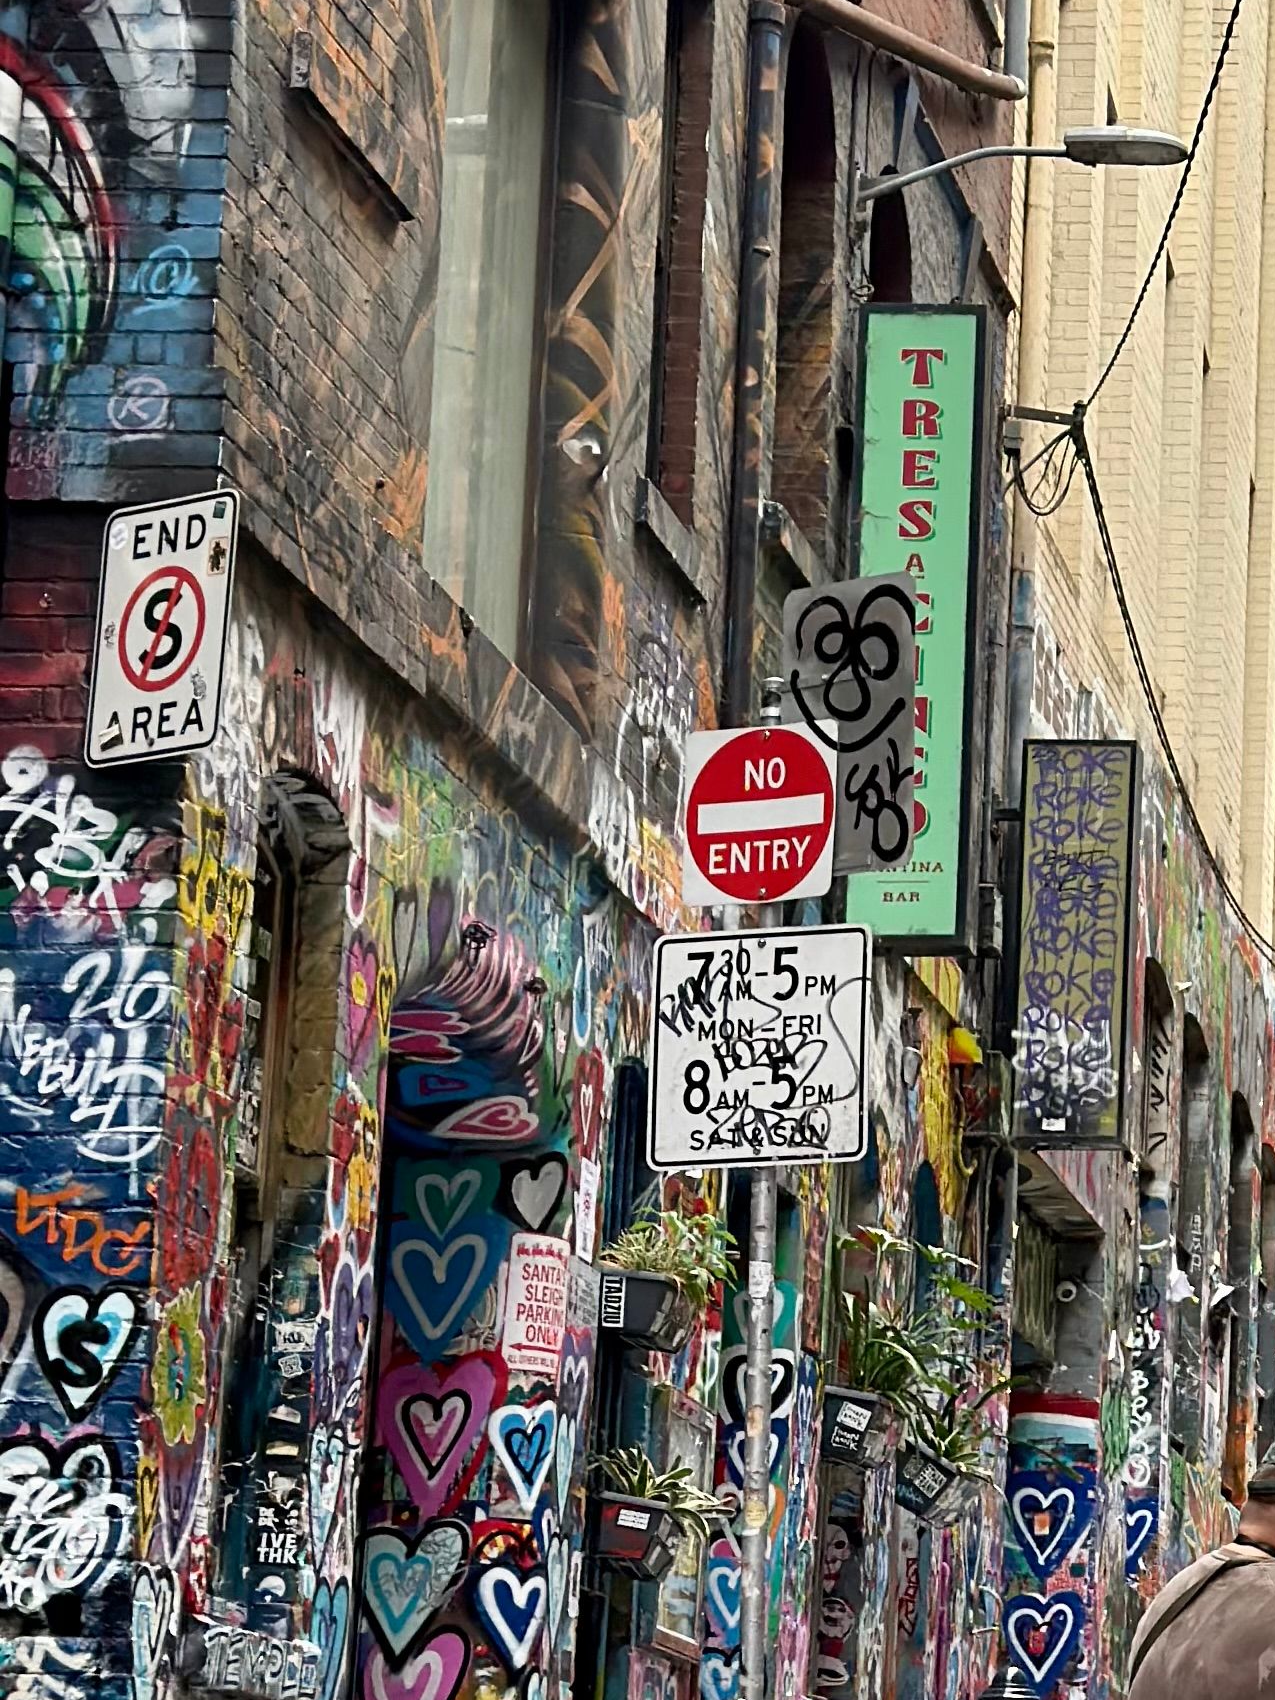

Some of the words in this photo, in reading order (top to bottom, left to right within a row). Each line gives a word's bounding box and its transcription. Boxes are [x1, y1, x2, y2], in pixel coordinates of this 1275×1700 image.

[899, 348, 947, 541] TRES
[132, 513, 207, 560] END
[138, 588, 183, 670] S
[744, 756, 787, 792] NO
[708, 835, 812, 875] ENTRY
[882, 891, 920, 902] BAR
[719, 980, 752, 1002] AM
[804, 975, 836, 997] PM
[783, 1013, 821, 1036] FRI
[683, 1059, 710, 1114] 8
[716, 1089, 749, 1109] AM
[803, 1084, 833, 1106] PM
